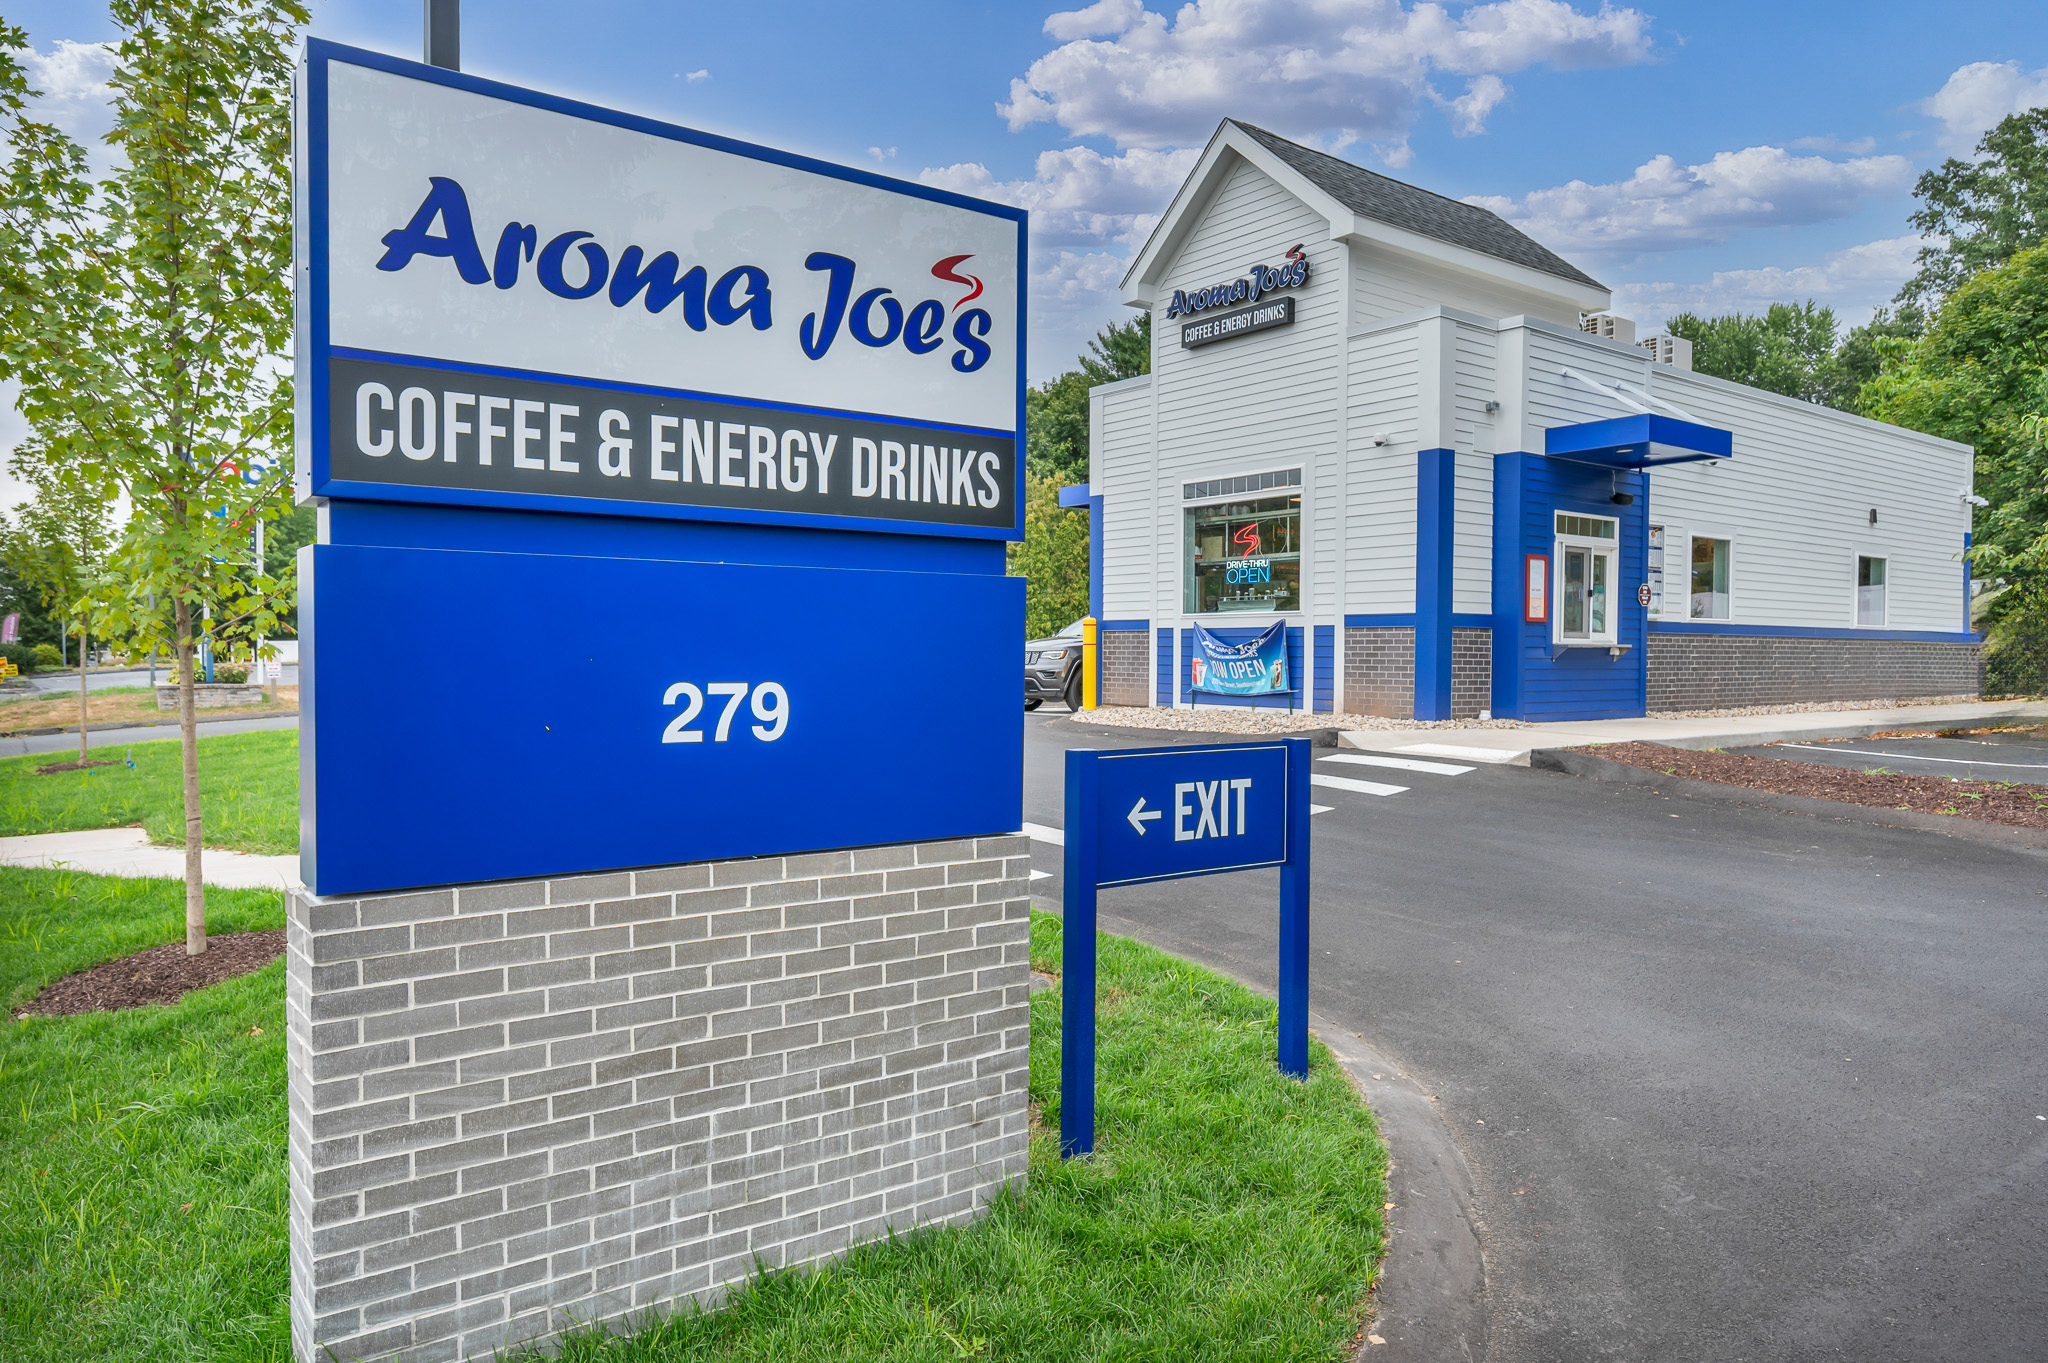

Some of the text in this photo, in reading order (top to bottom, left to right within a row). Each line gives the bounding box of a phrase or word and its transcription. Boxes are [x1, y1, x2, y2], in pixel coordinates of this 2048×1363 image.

[375, 176, 773, 332] Aroma
[1166, 278, 1250, 320] Aroma
[1185, 303, 1285, 343] COFFEE & ENERGY DRINKS
[355, 382, 1000, 510] COFFEE & ENERGY DRINKS
[1226, 567, 1270, 584] OPEN
[1228, 658, 1267, 680] OPEN
[662, 681, 790, 744] 279
[1174, 778, 1252, 842] EXIT
